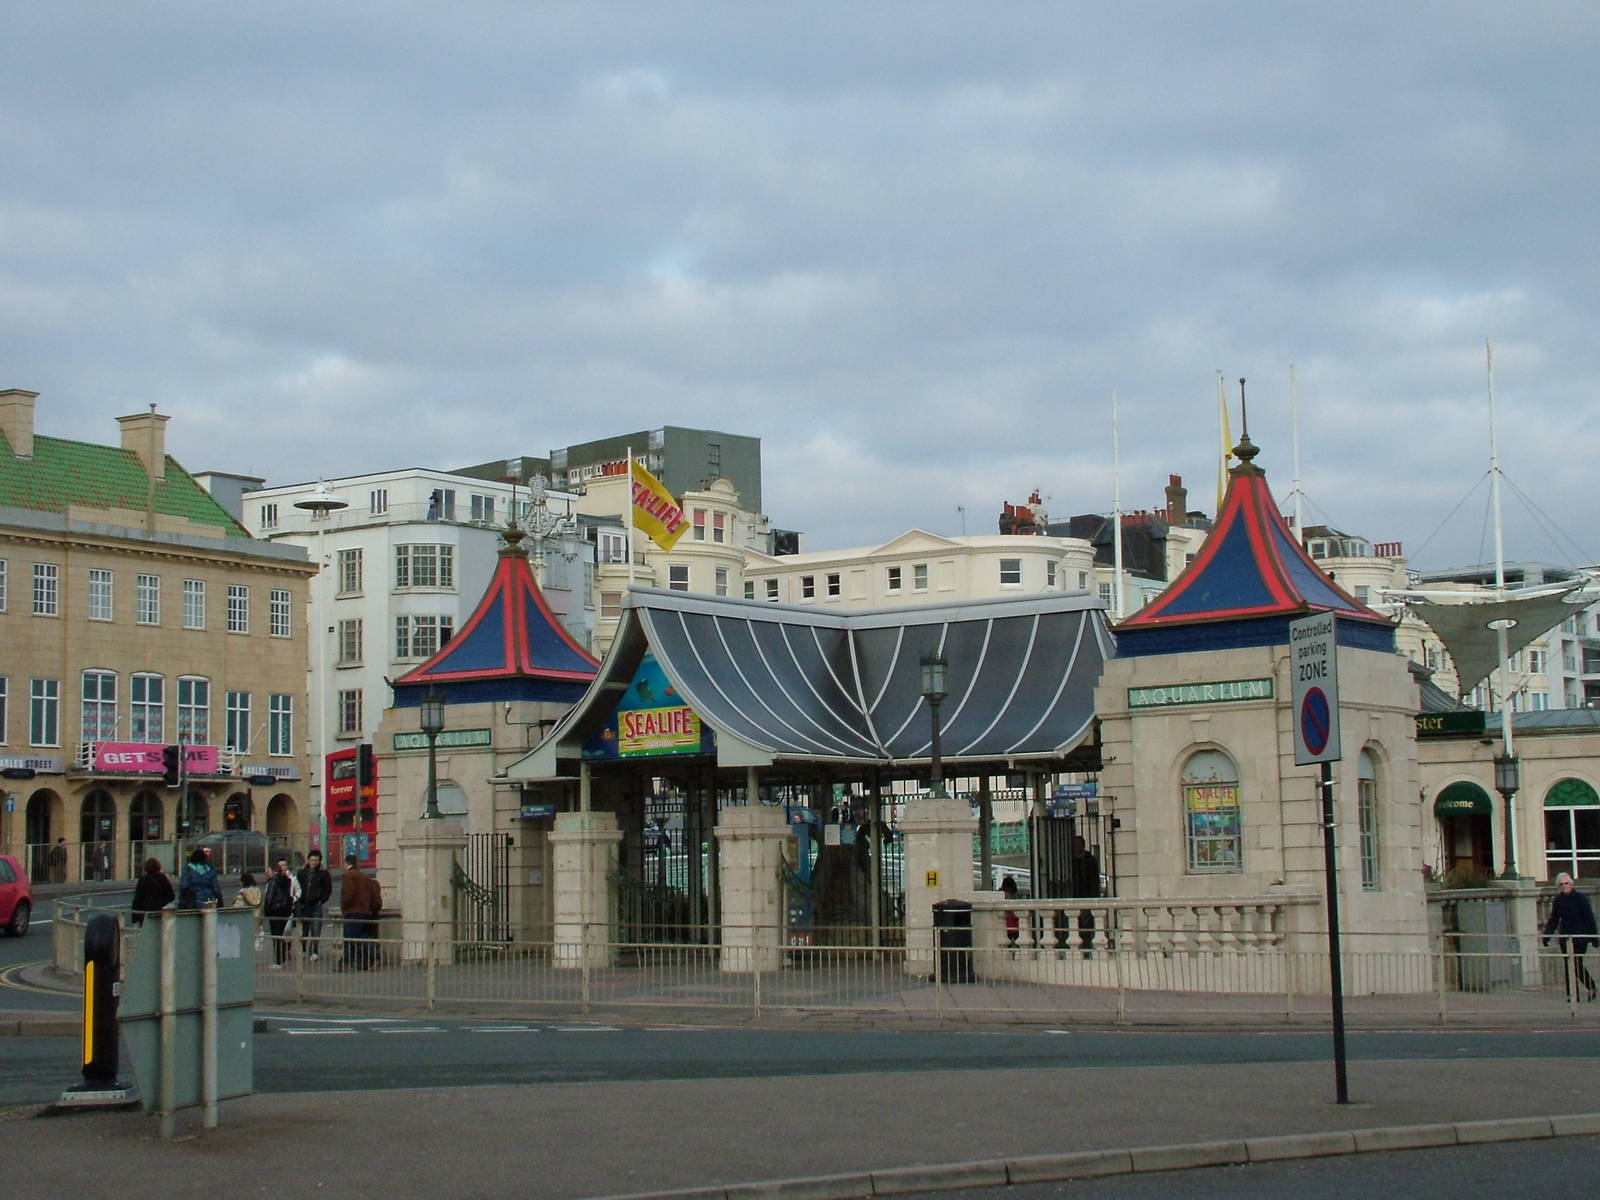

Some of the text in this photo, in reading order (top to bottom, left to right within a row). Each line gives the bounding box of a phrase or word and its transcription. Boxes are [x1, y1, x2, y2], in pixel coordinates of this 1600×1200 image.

[1292, 620, 1332, 641] Controlled
[1298, 642, 1327, 658] parking
[1299, 660, 1328, 682] ZONE
[1137, 681, 1265, 705] AQUARIUM
[25, 759, 52, 769] STREET
[268, 767, 289, 776] STREET
[330, 785, 353, 795] forever
